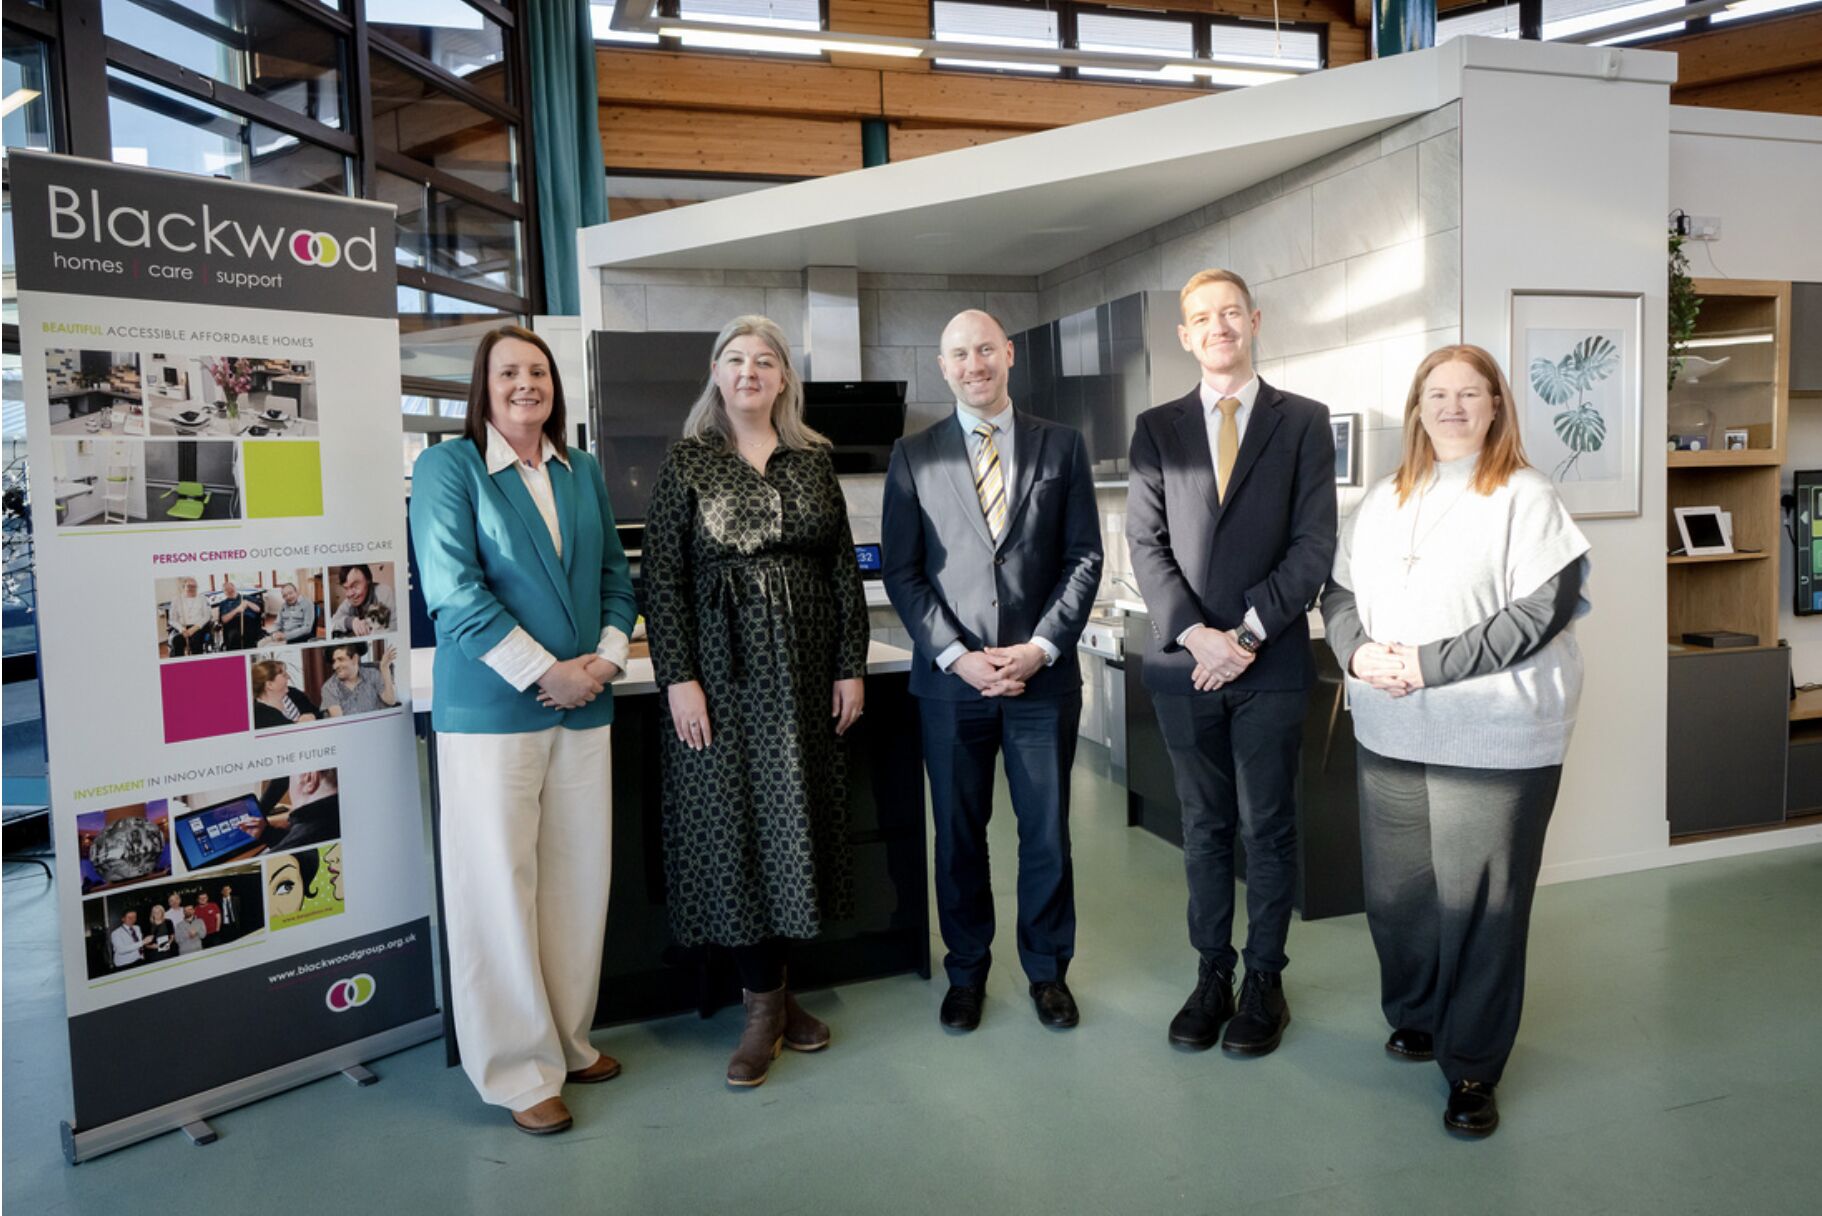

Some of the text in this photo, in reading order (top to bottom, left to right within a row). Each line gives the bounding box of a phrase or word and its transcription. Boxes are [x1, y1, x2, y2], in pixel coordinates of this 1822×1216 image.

[48, 184, 377, 272] Blackwood
[53, 251, 283, 289] homes care support
[42, 321, 314, 347] BEAUTIFUL ACCESSIBLE AFFORDABLE HOMES
[152, 540, 393, 564] PERSON CENTRED OUTCOME FOCUSED CARE
[74, 746, 337, 800] INVESTMENT IN INNOVATION AND THE FUTURE
[268, 934, 416, 983] www.blackwoodgroup.org.uk
